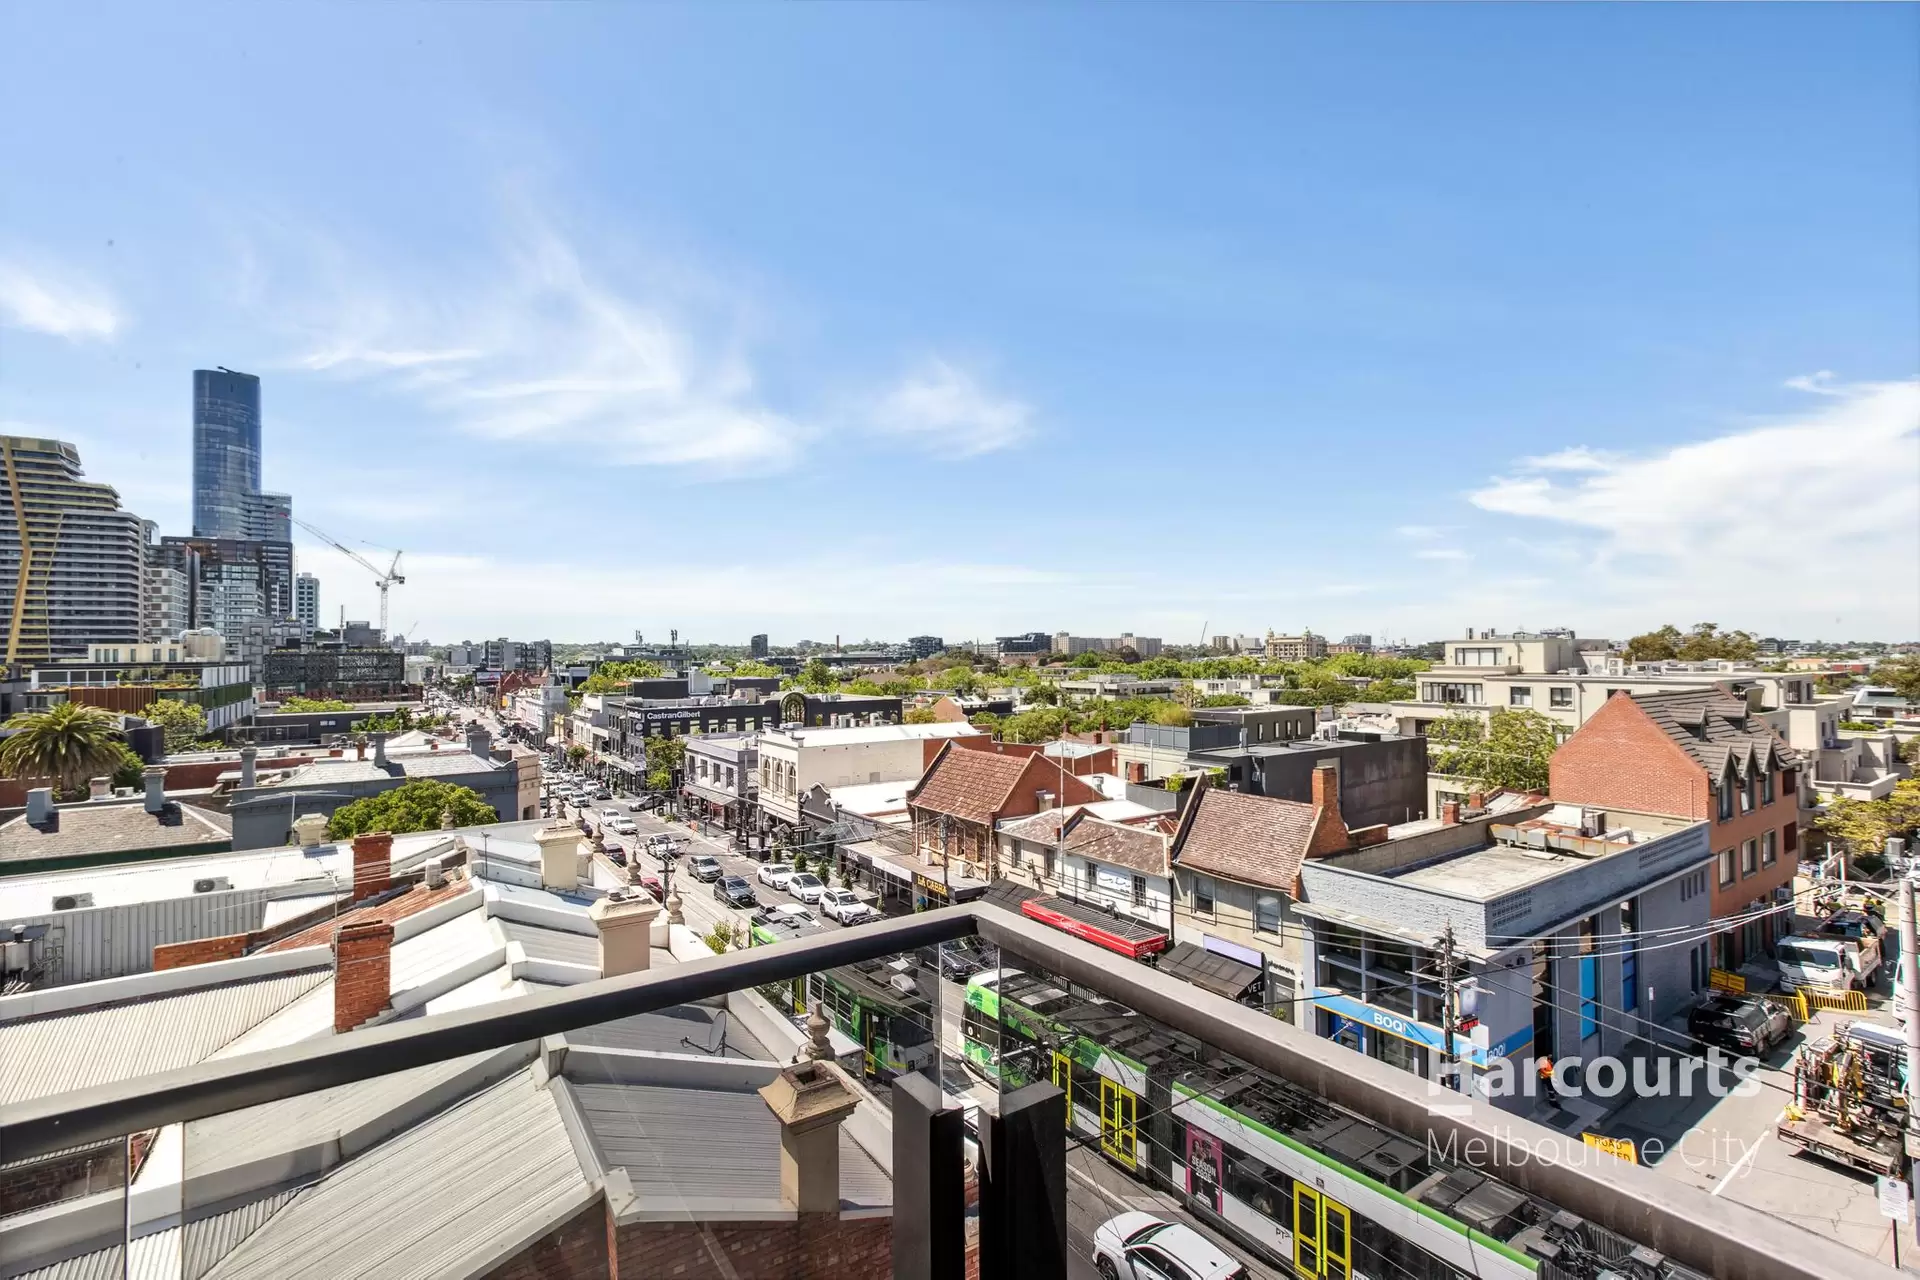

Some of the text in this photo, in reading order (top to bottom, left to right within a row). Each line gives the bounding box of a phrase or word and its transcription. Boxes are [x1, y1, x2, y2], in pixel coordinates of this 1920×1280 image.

[647, 711, 701, 720] CastranGilbert
[1247, 982, 1262, 994] VET
[1374, 1012, 1403, 1033] BOQ
[1191, 1156, 1217, 1177] SEASON
